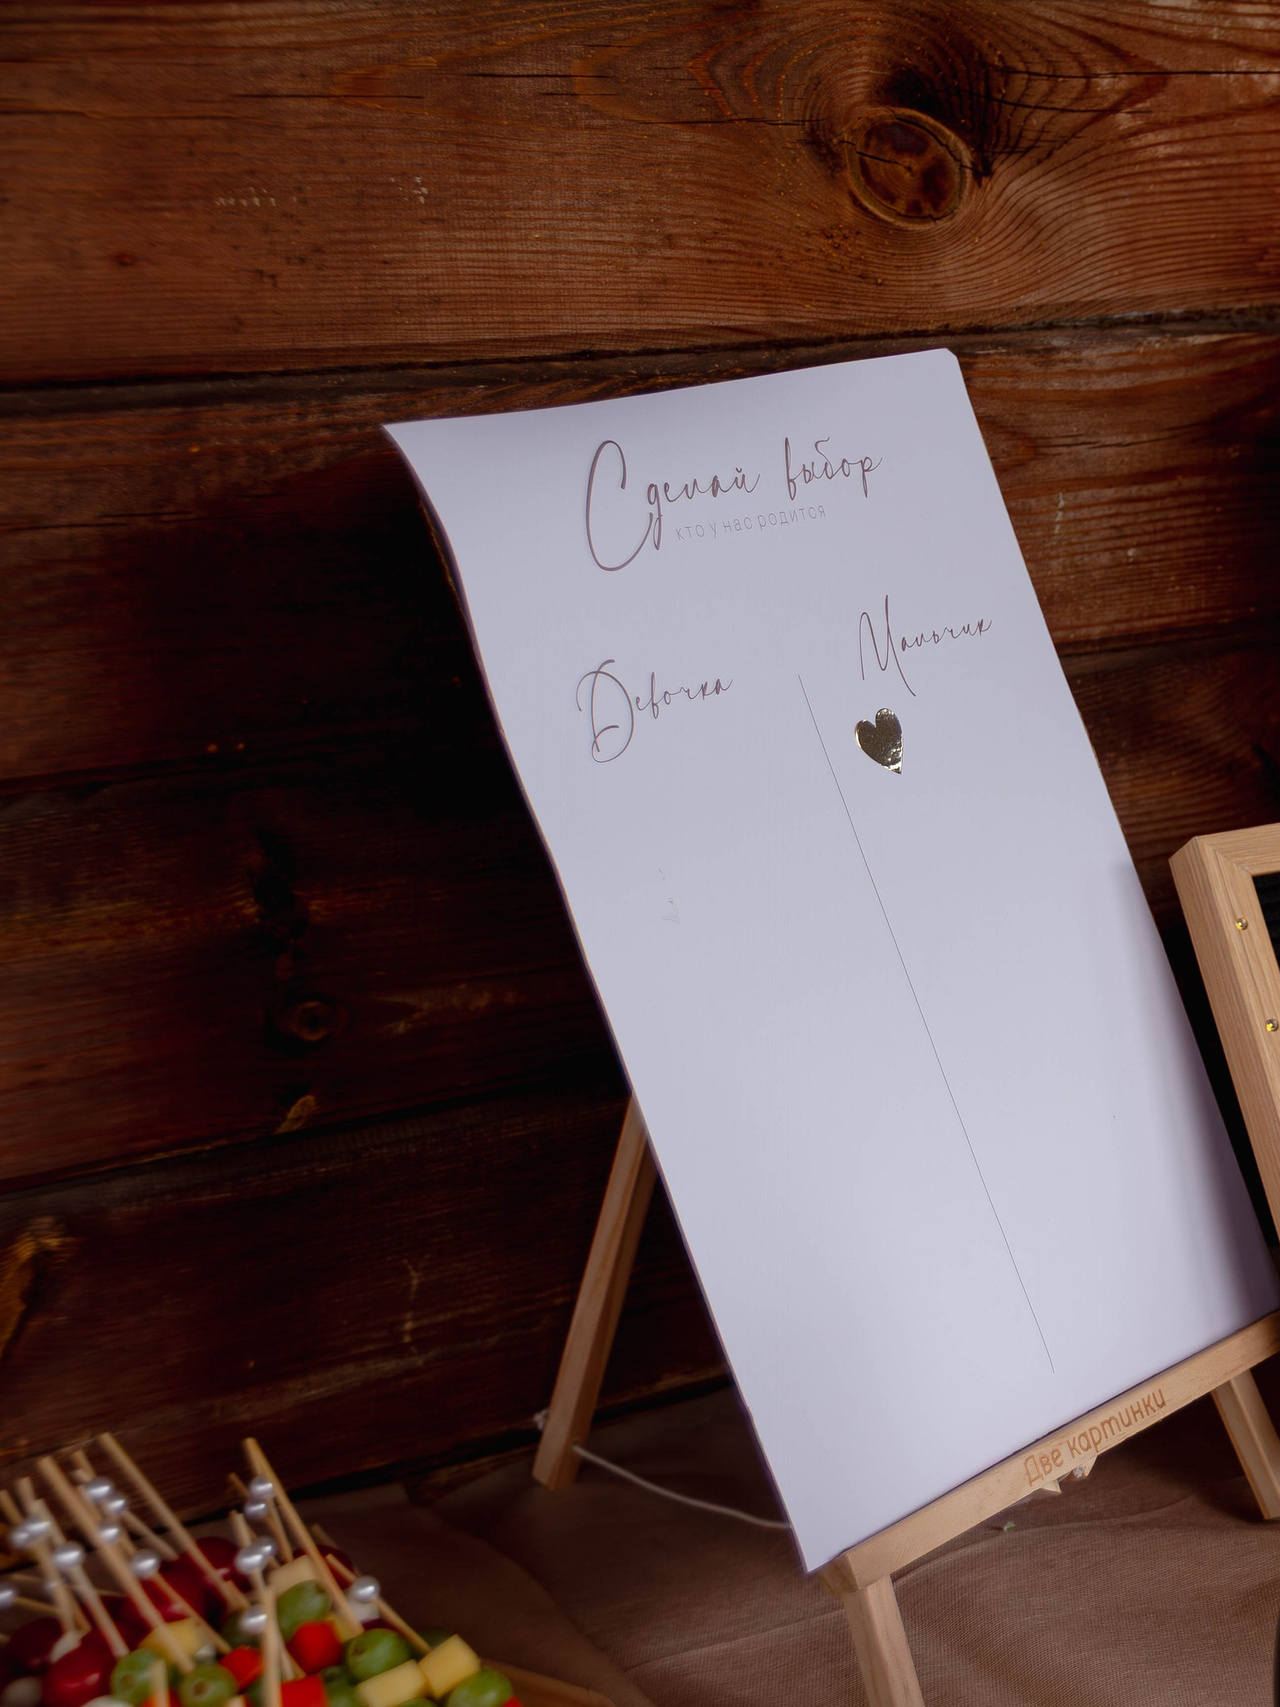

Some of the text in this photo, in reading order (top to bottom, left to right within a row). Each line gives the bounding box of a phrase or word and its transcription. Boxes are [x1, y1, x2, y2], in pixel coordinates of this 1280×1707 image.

[585, 437, 884, 572] Сделай выбор
[675, 505, 826, 541] кто у нас родится
[859, 594, 993, 697] Мальчик
[576, 658, 734, 763] Девочка
[1023, 1388, 1167, 1487] Две картинки
